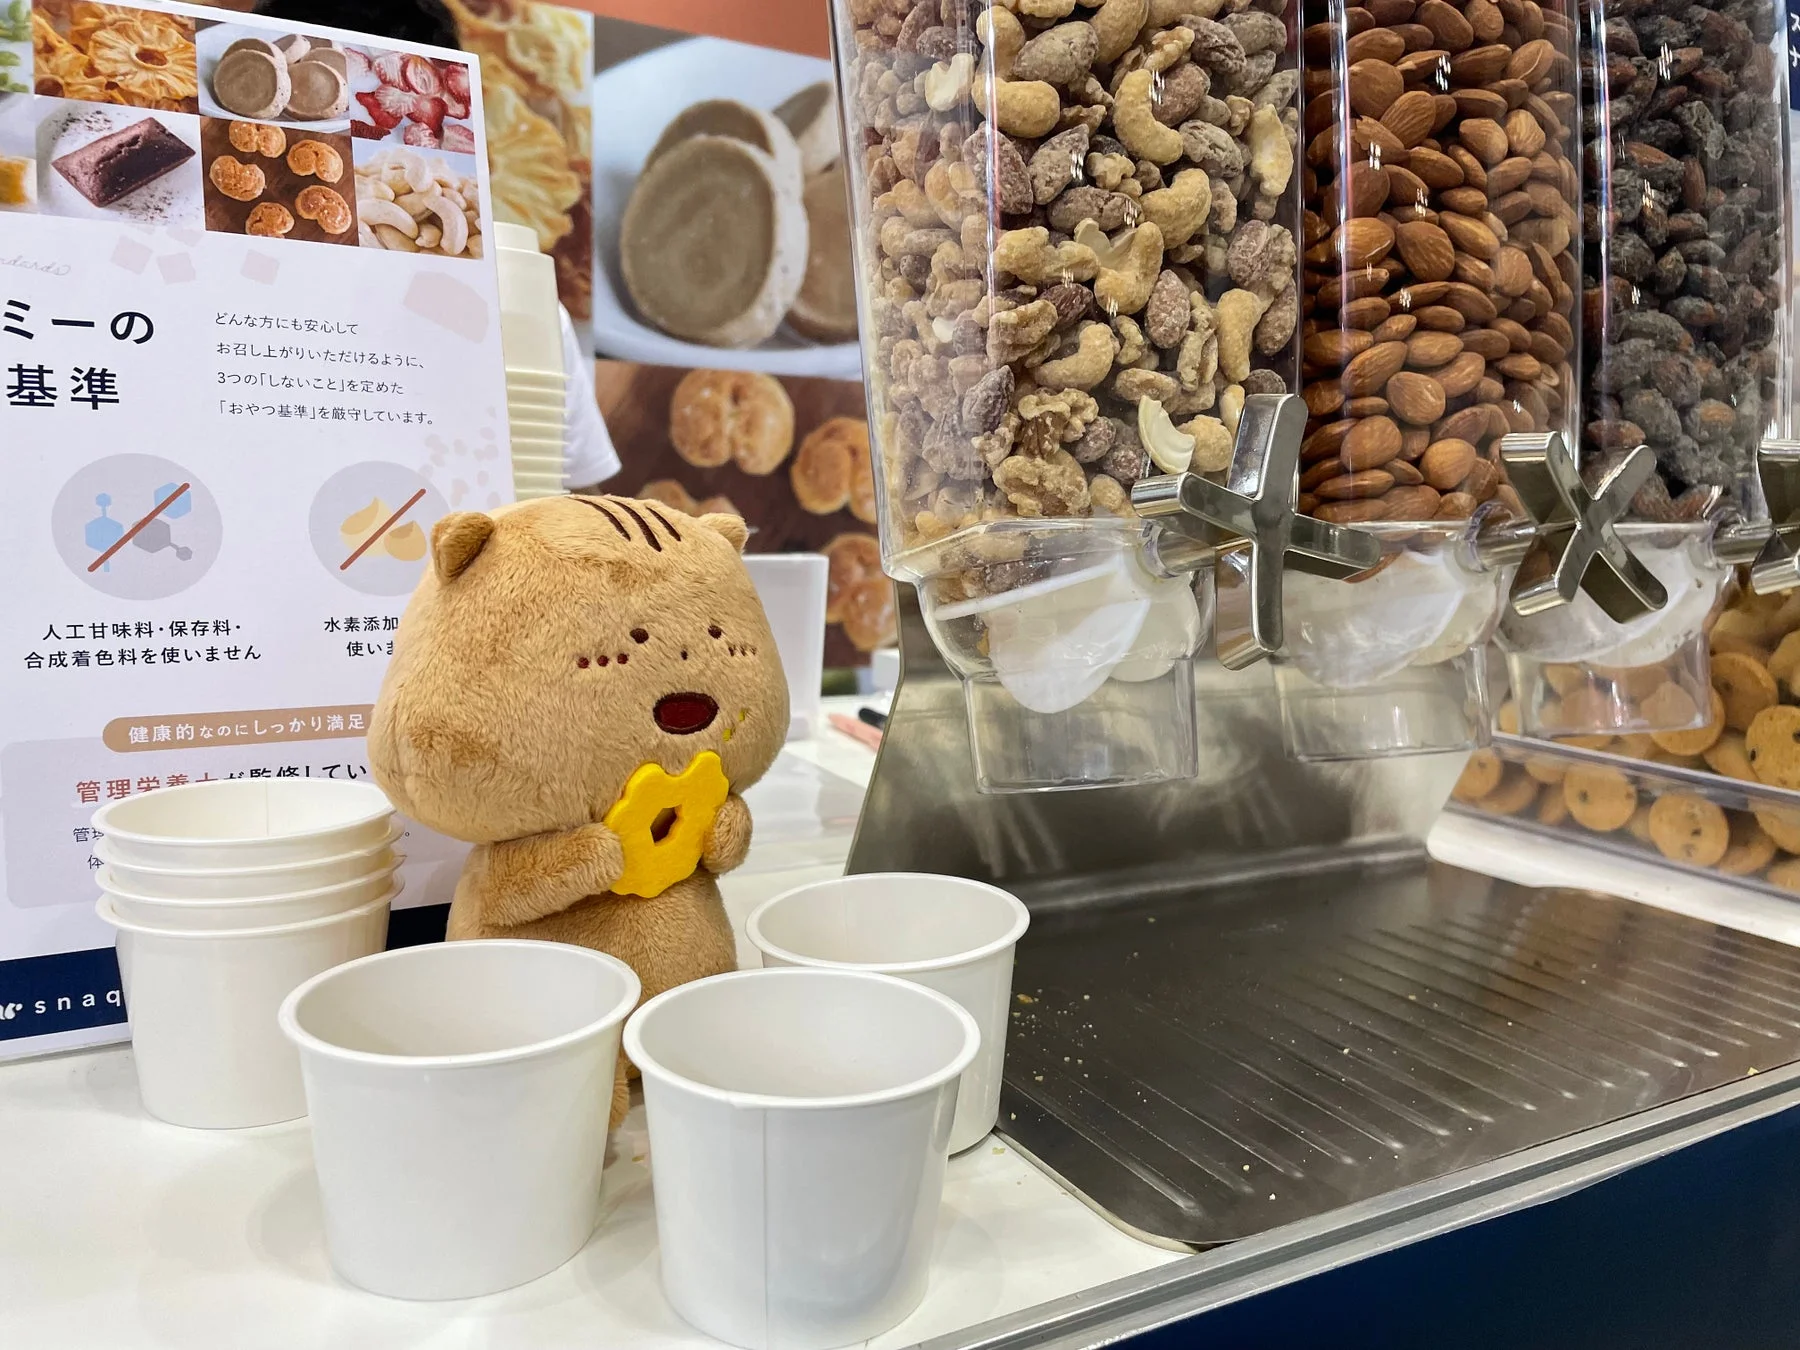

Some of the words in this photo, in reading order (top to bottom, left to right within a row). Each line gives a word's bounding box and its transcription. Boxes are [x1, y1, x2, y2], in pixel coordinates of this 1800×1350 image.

[3, 299, 154, 345] ミーの
[215, 312, 359, 335] どんな方にも安心して
[216, 342, 425, 369] お召し上がりいただけるように、
[6, 363, 120, 411] 基準
[217, 371, 405, 395] 3つの「しないこと」を定めた
[219, 400, 434, 425] 「おやつ基準」を厳守しています。
[324, 615, 399, 633] 水素添加
[24, 645, 262, 669] 合成着色料を使いません
[35, 989, 121, 1014] snaq
